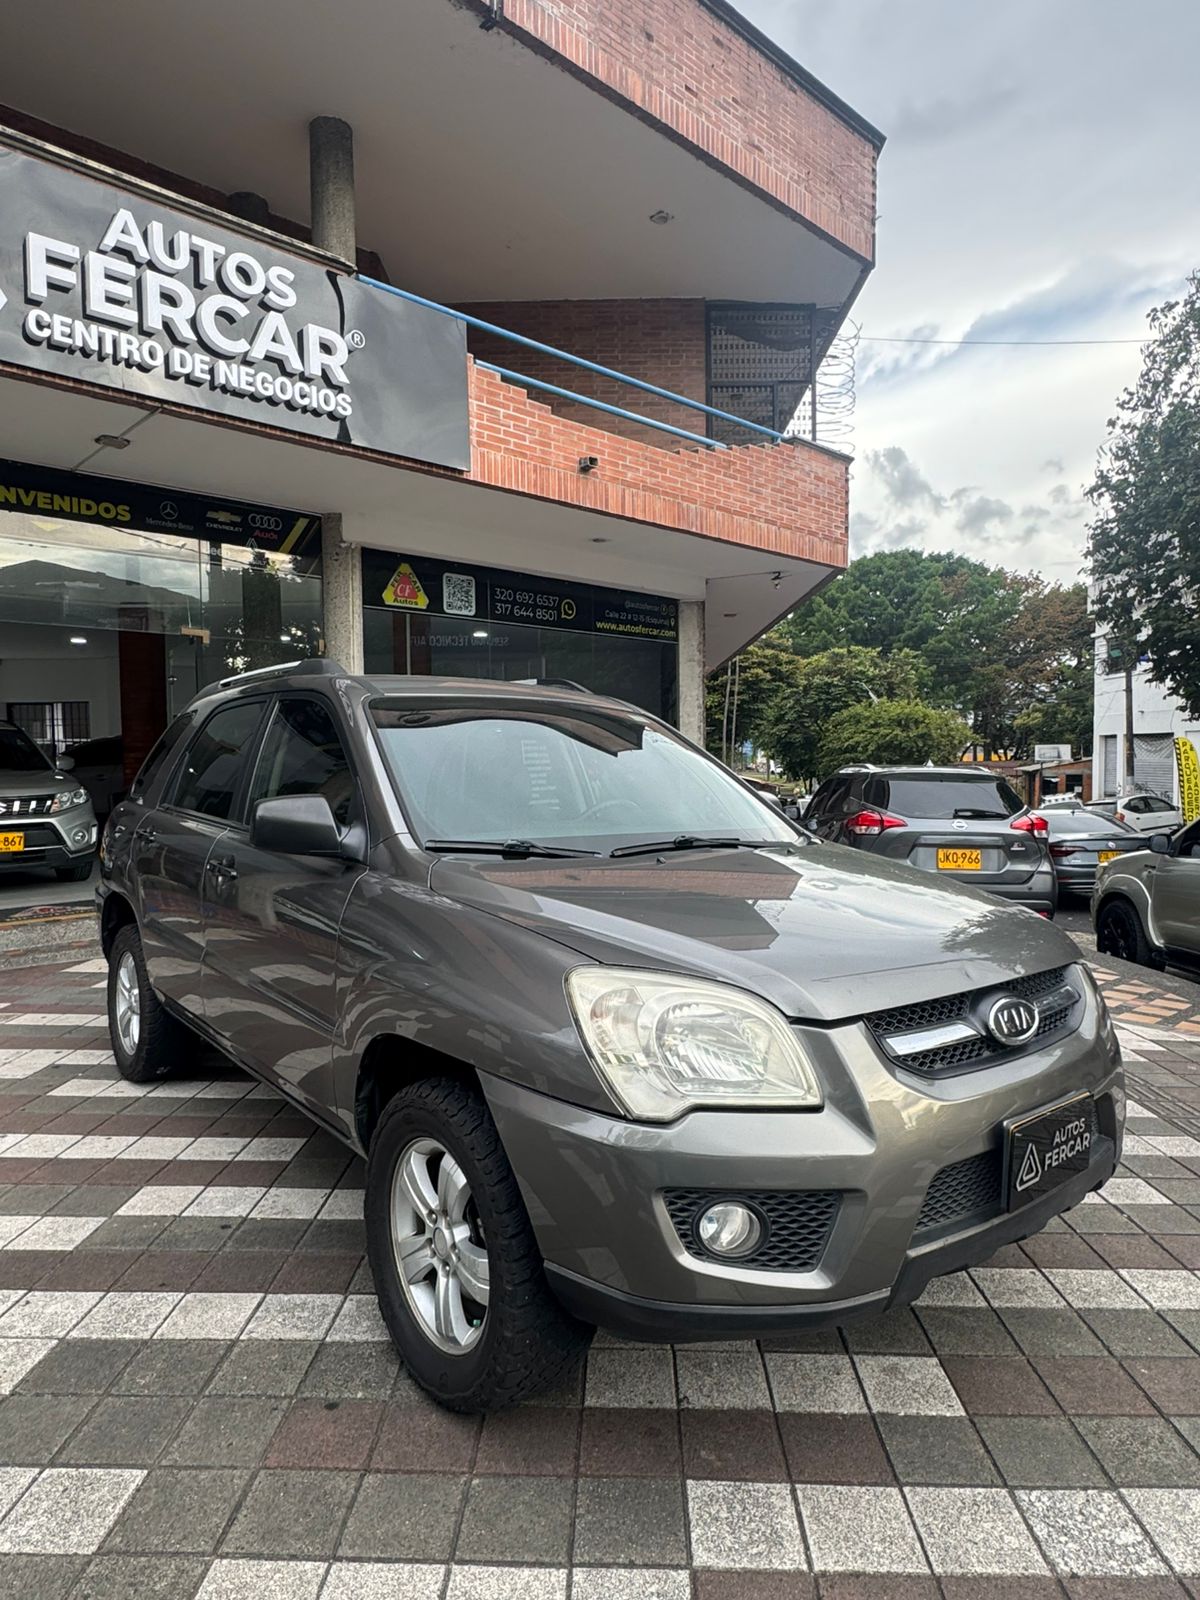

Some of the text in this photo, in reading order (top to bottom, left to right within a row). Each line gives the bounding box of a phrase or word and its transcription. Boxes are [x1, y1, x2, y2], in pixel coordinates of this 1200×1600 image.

[100, 208, 297, 309] AUTOS
[26, 232, 350, 385] FERCAR
[26, 309, 353, 418] CENTRO DE NEGOCIOS
[494, 587, 559, 607] 320 692 6537
[494, 602, 557, 621] 317 644 8501
[595, 620, 676, 637] www.autosfercar.com
[1181, 741, 1194, 822] PARQUEADERO
[996, 1005, 1032, 1034] KIA
[1053, 1117, 1086, 1147] AUTOS
[1044, 1132, 1091, 1171] FERCAR
